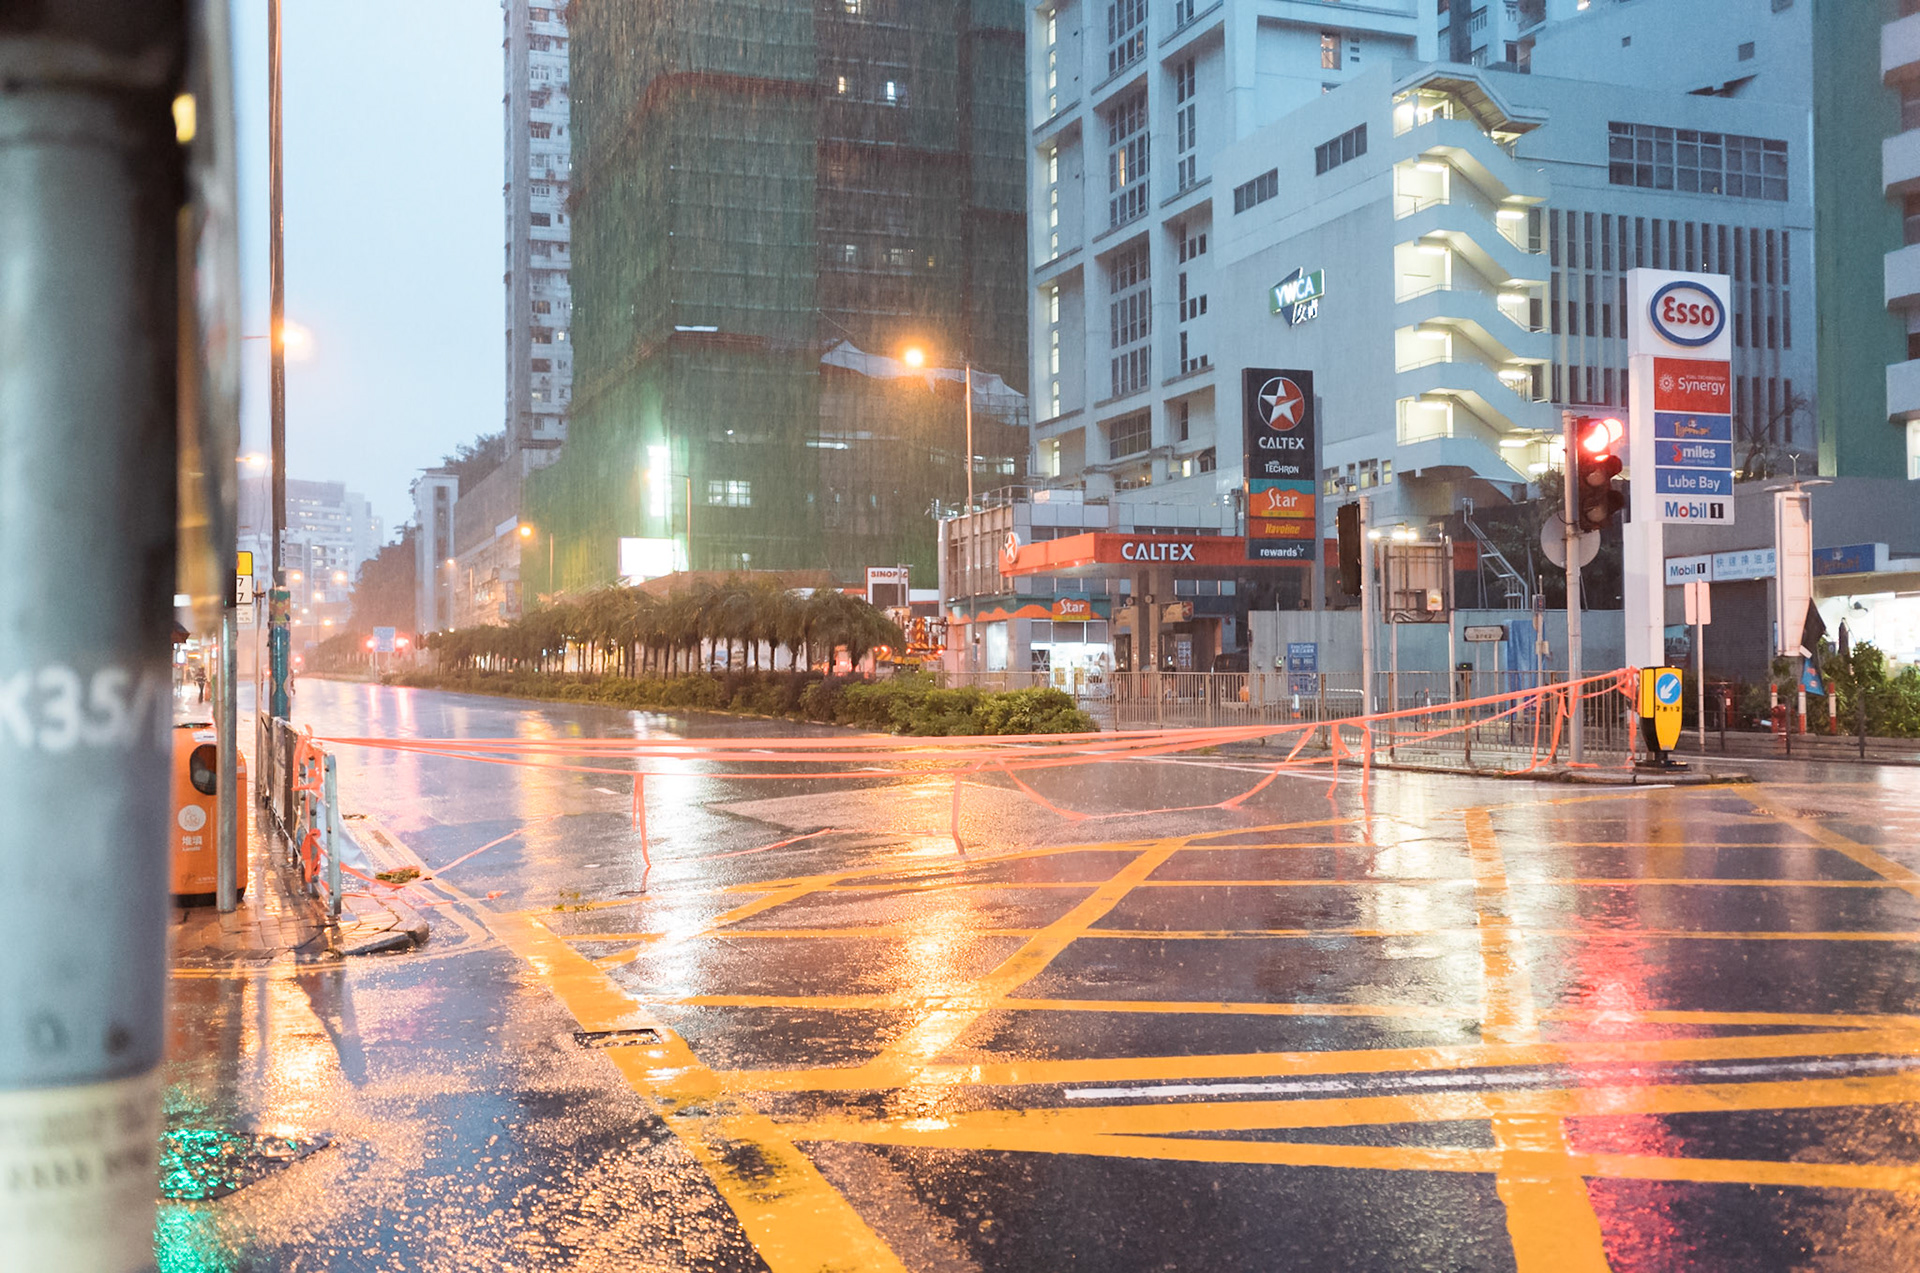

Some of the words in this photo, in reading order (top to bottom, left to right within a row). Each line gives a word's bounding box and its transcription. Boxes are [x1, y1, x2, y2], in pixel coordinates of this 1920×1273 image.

[1275, 275, 1315, 307] YWCA
[1678, 377, 1726, 395] Synergy
[1258, 437, 1305, 450] CALTEX
[1264, 463, 1300, 475] TECHRON
[1667, 475, 1696, 489] Lube
[1699, 476, 1721, 492] Bay
[1268, 488, 1298, 510] Star
[1665, 502, 1707, 518] Mobil
[1712, 503, 1722, 518] 1
[1121, 542, 1196, 561] CALTEX
[1260, 547, 1298, 557] rewards
[1670, 564, 1696, 577] Mobil
[1060, 598, 1085, 615] Star
